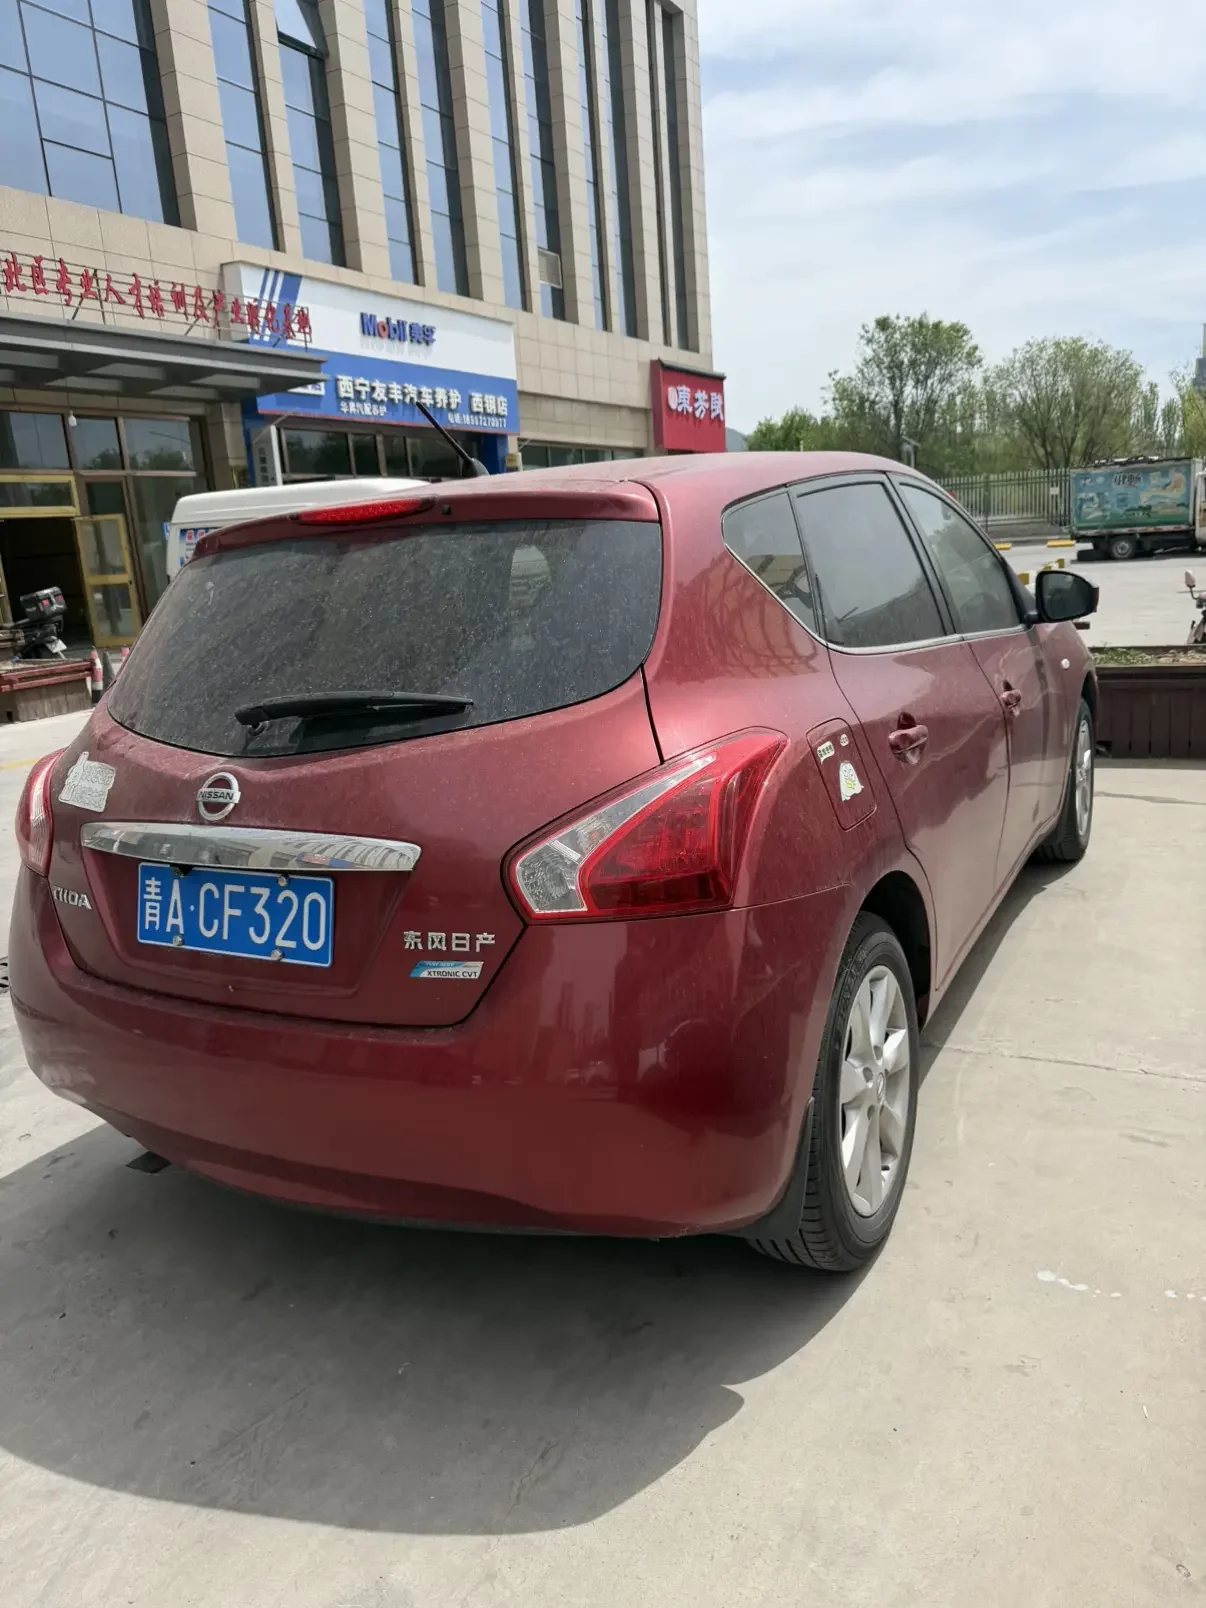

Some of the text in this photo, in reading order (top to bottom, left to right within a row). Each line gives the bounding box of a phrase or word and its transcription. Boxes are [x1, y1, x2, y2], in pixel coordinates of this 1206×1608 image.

[360, 312, 407, 342] Mobil
[198, 790, 235, 801] NISSAN
[52, 885, 93, 910] TIIDA
[403, 930, 495, 953] 东风日产
[427, 970, 479, 978] XTRONIC CVT
